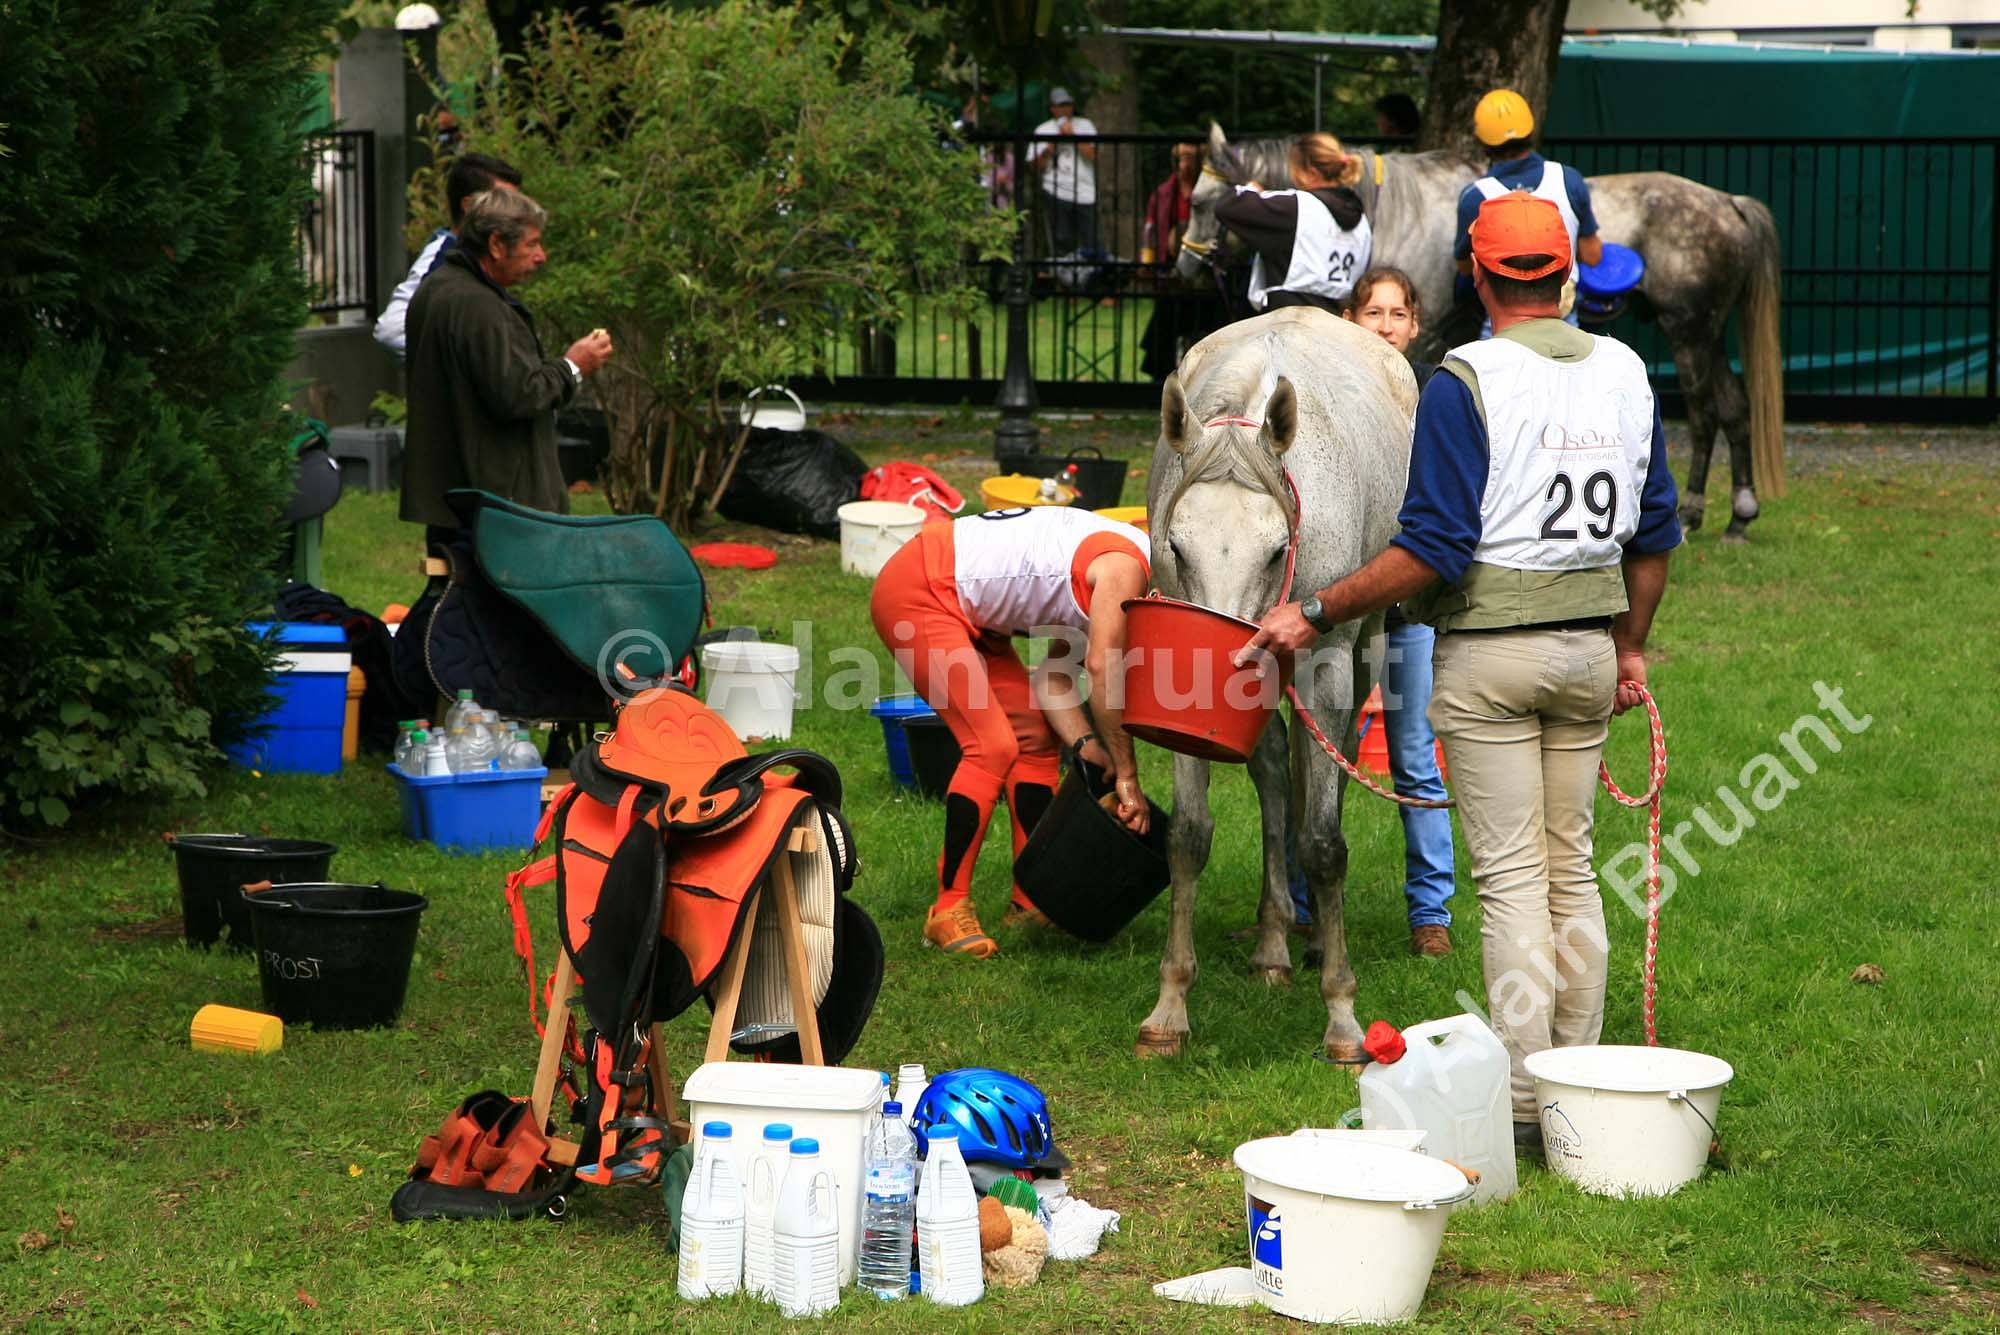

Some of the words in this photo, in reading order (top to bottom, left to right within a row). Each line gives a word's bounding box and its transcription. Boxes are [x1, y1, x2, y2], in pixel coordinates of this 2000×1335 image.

[1539, 470, 1618, 541] 29
[263, 949, 323, 980] PROST
[1545, 1131, 1570, 1151] Lotte
[1253, 1261, 1284, 1290] Lotte
